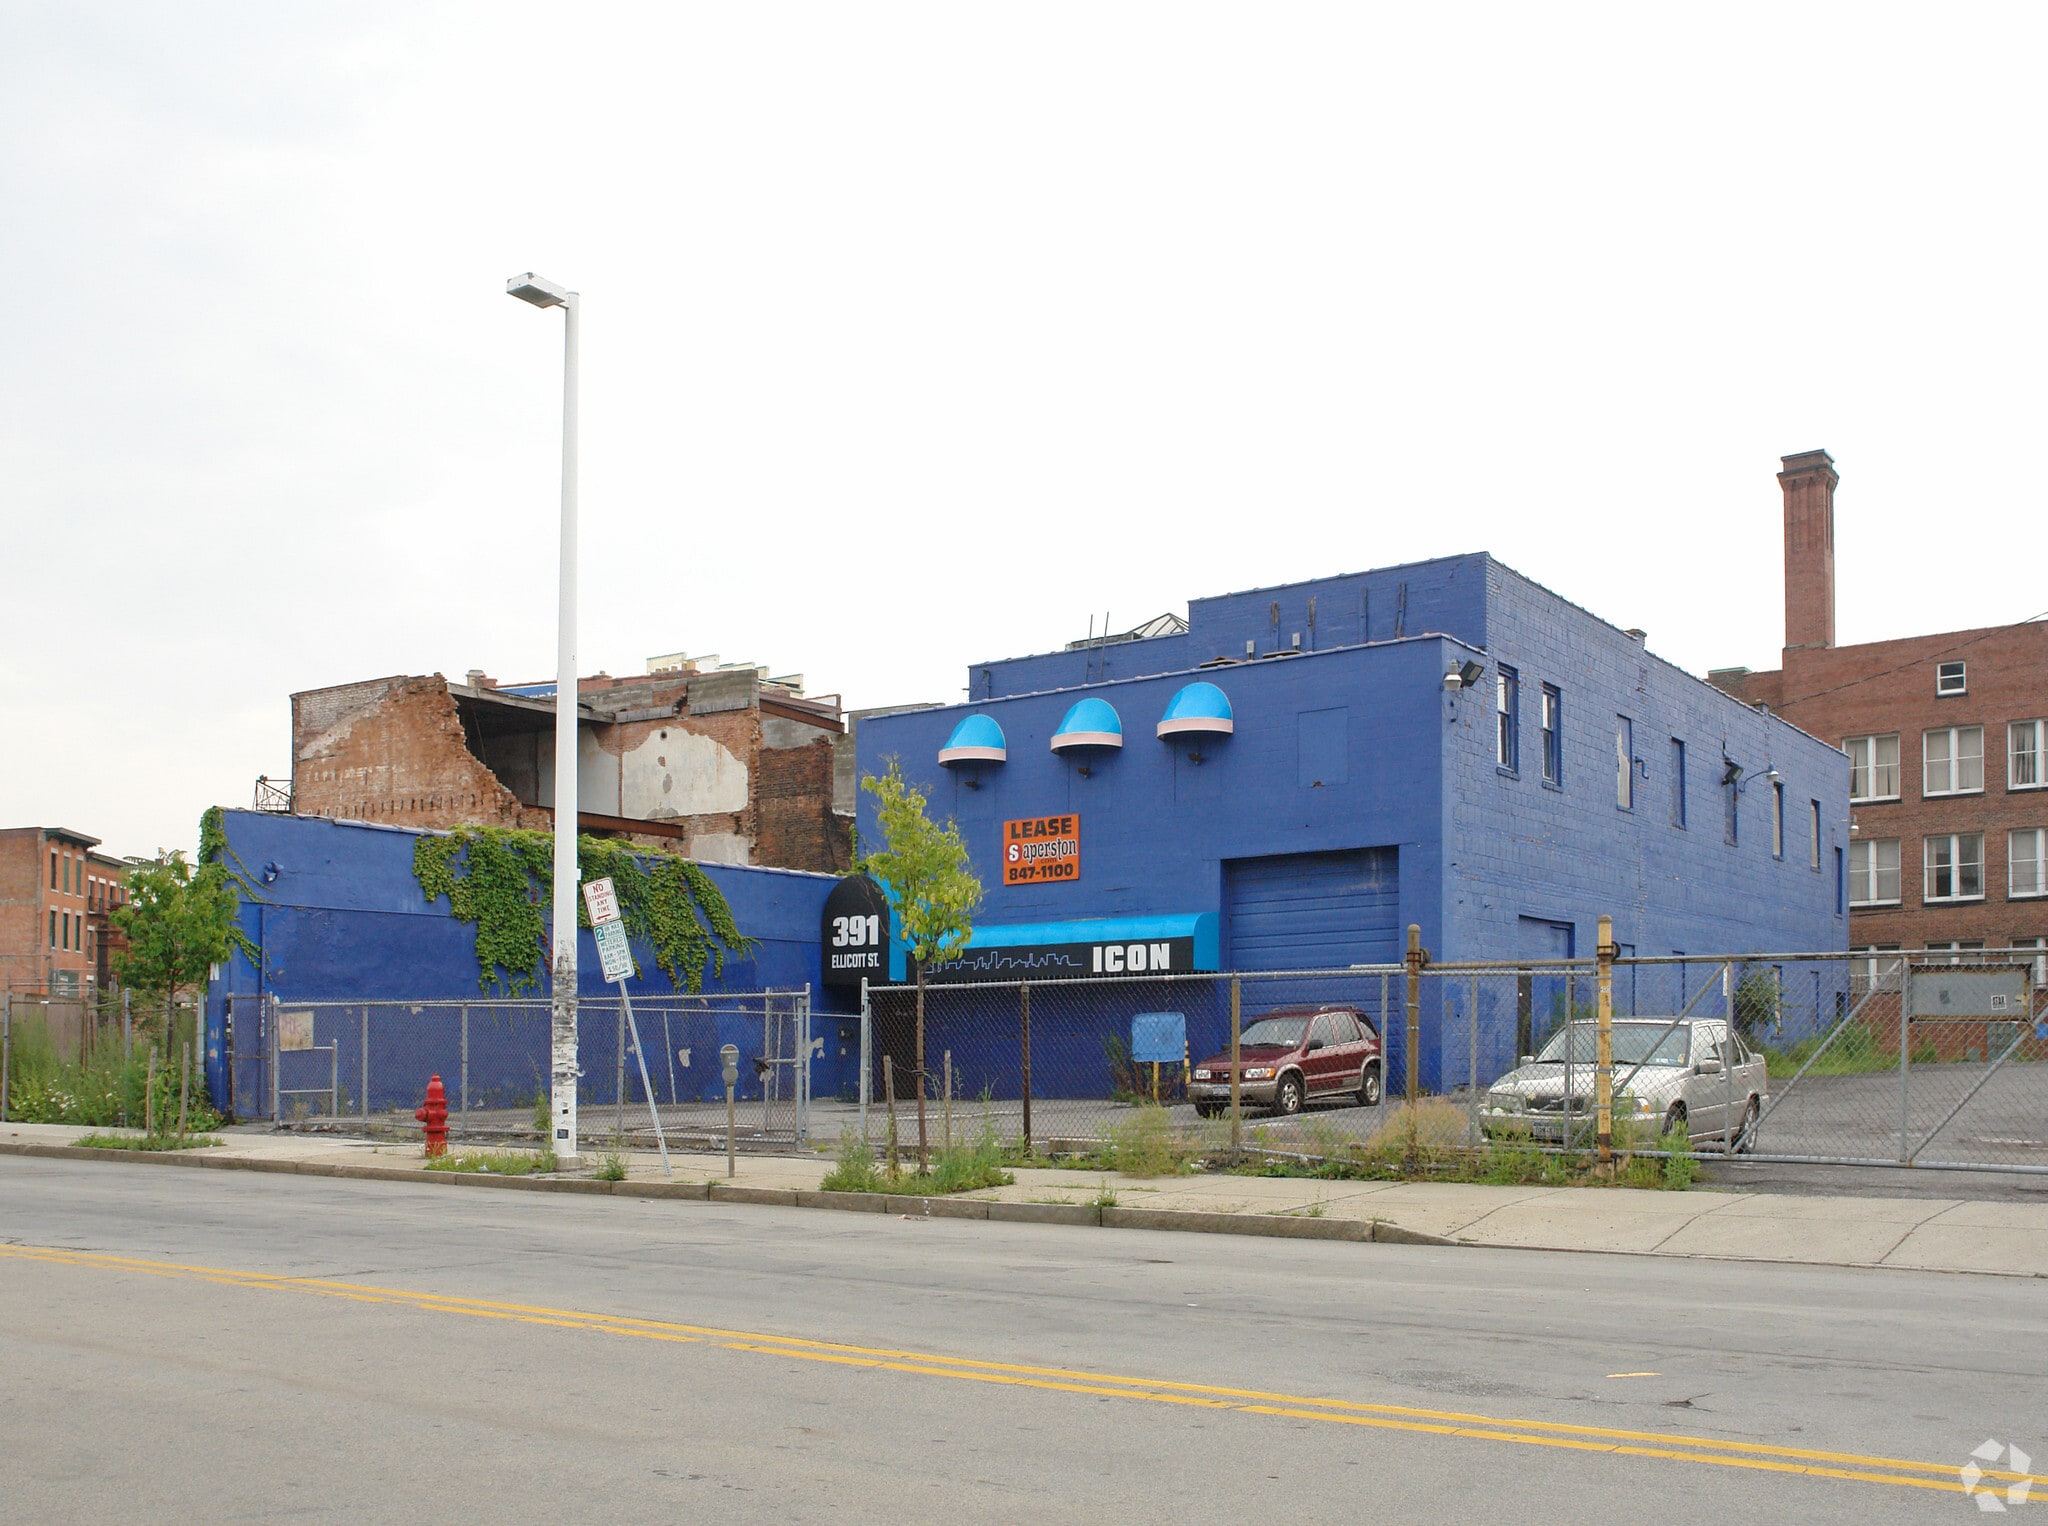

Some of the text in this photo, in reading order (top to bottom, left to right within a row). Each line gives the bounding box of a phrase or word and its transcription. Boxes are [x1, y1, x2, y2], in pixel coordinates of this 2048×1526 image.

[1011, 817, 1072, 839] LEASE
[1009, 863, 1073, 881] 847-1100
[592, 883, 604, 894] NO
[588, 890, 613, 902] STANDING
[597, 899, 608, 907] ANY
[597, 905, 610, 913] TIME
[596, 928, 605, 941] 2
[832, 914, 879, 947] 391
[602, 943, 624, 953] PARKING
[831, 952, 880, 969] ELLICOTT ST.
[1092, 943, 1170, 972] ICON
